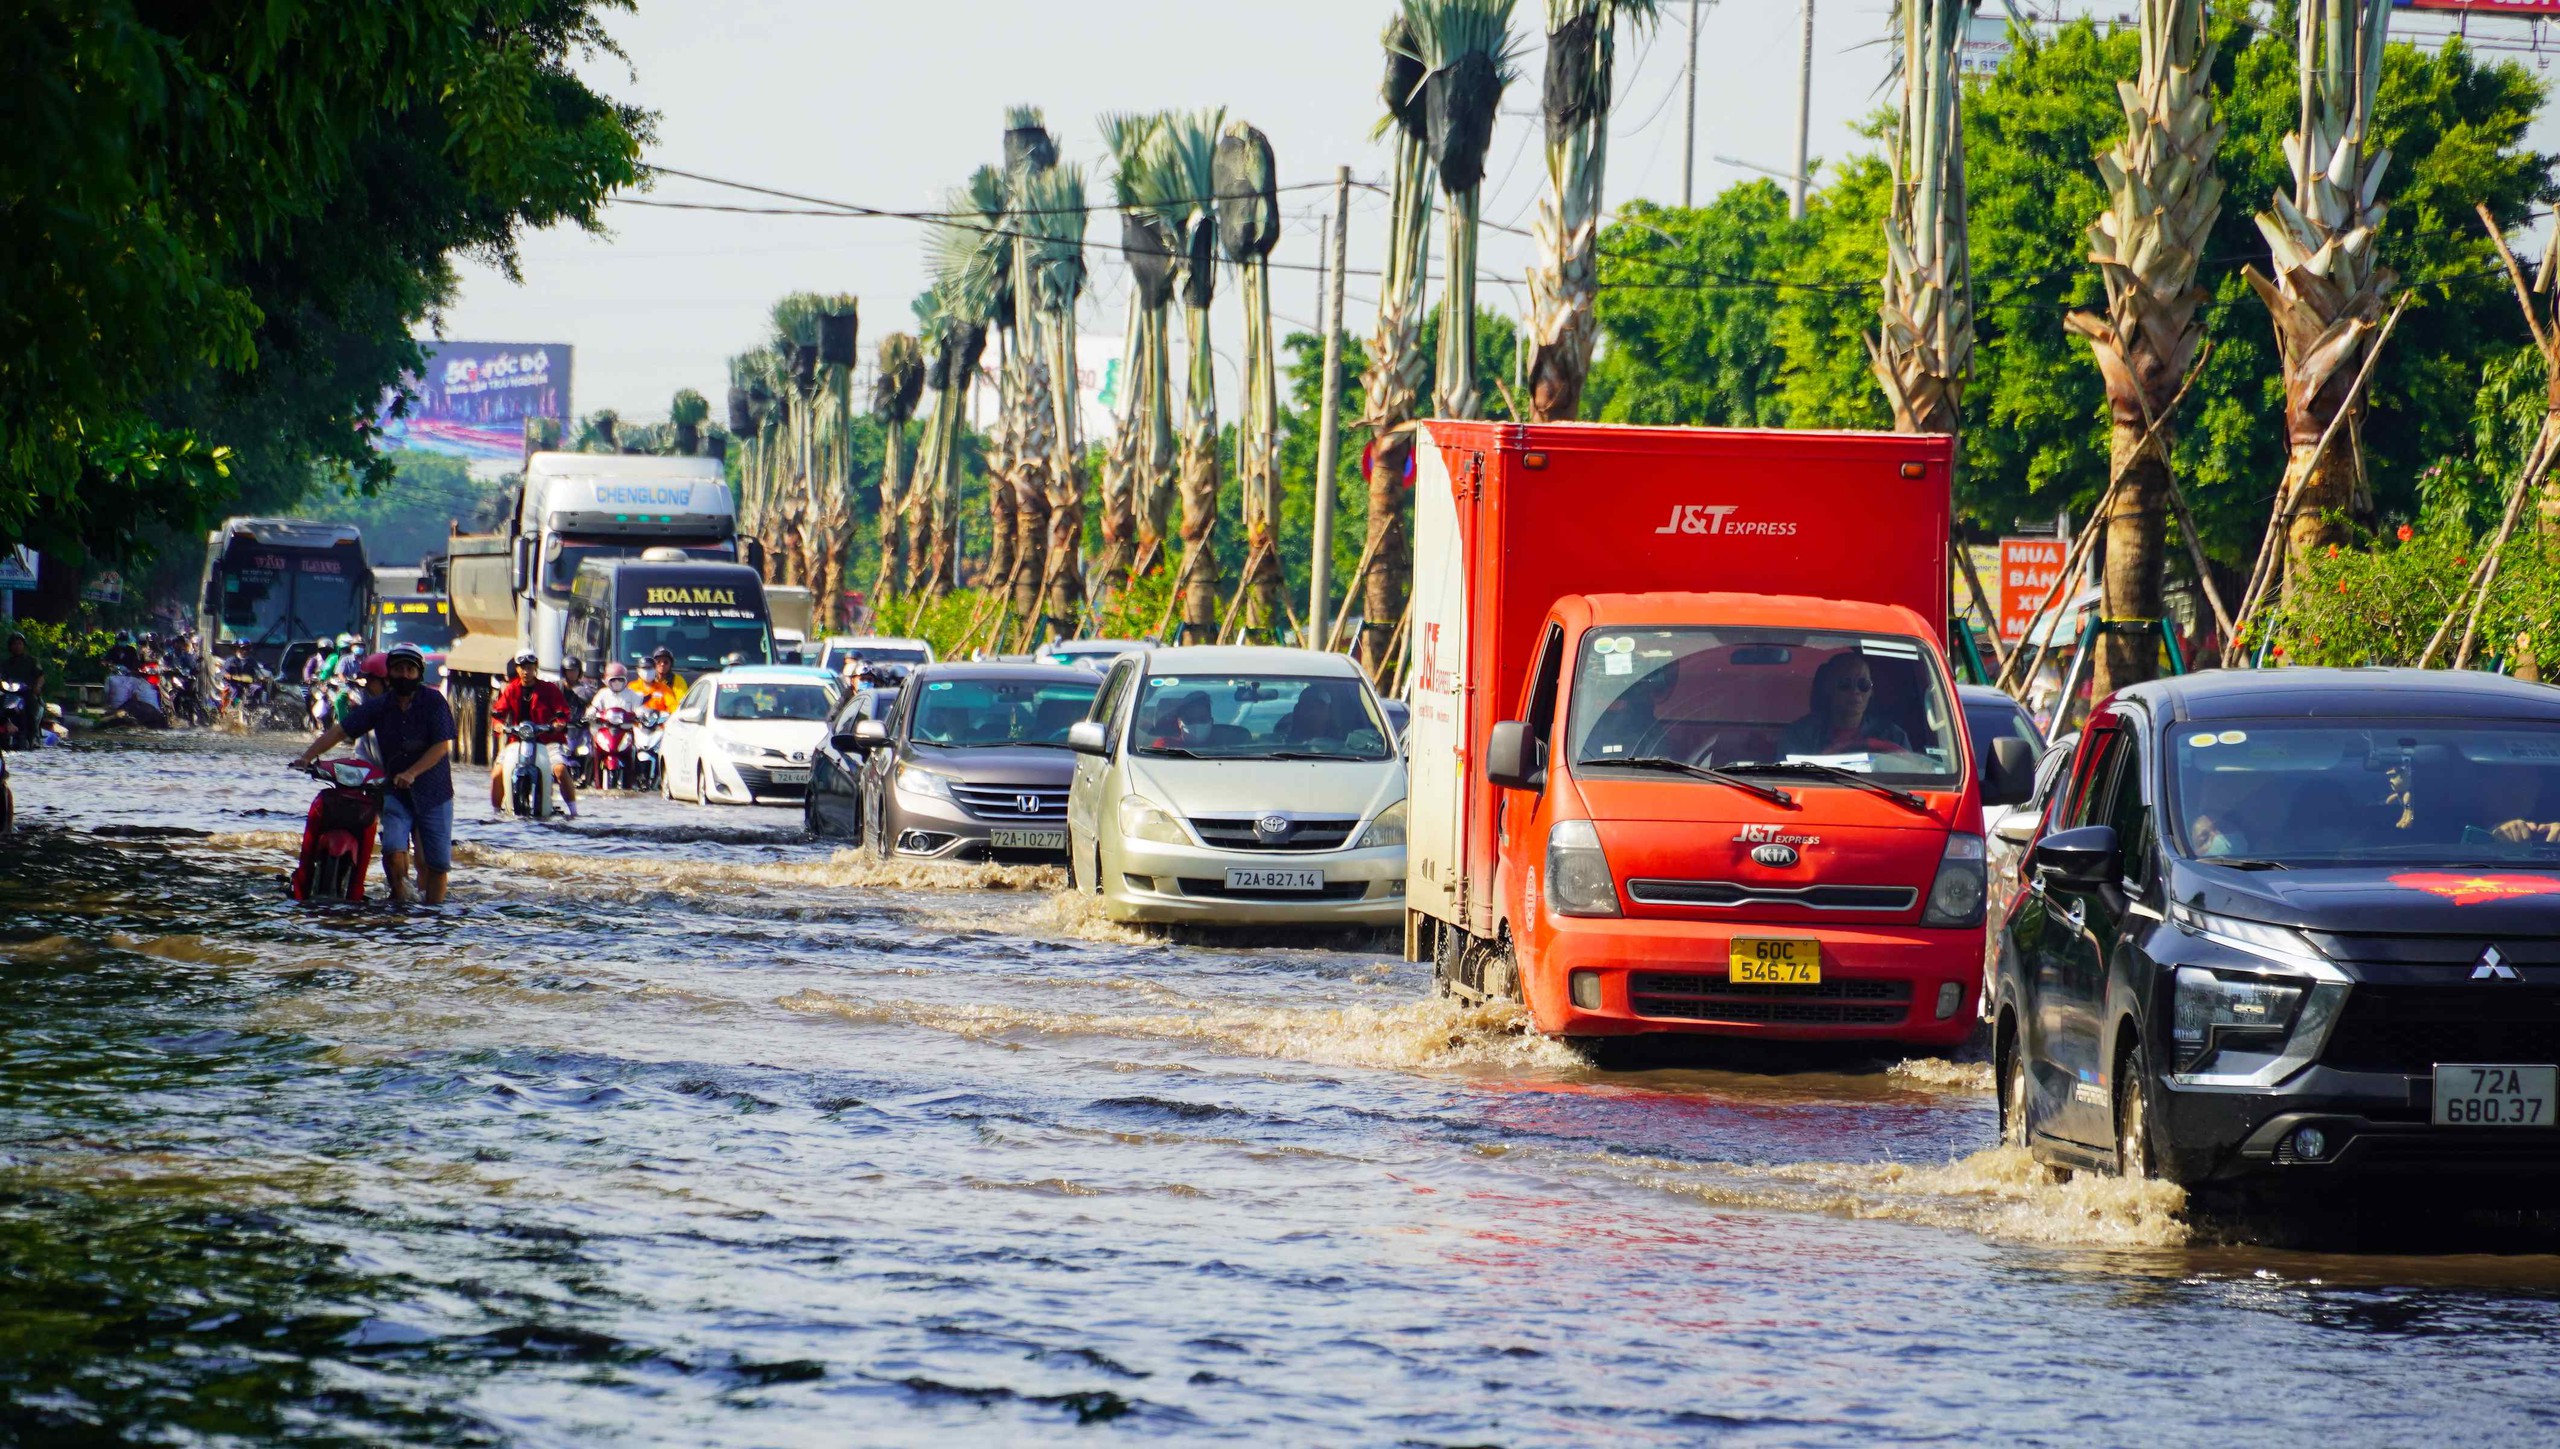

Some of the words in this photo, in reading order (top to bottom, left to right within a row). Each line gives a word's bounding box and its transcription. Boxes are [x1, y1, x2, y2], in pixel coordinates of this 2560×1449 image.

[596, 486, 689, 506] CHENGLONG
[1655, 504, 1739, 534] J&T
[1725, 521, 1797, 535] EXPRESS
[2008, 546, 2058, 563] MUA
[2009, 566, 2058, 588] BÁN
[994, 832, 1062, 847] 72A-102.77
[1732, 823, 1785, 842] J&T
[1775, 835, 1820, 845] EXPRESS
[1760, 848, 1791, 862] KIA
[1234, 872, 1315, 887] 72A-827.14
[1757, 942, 1794, 960] 60C
[1742, 961, 1811, 981] 546.74
[2471, 1069, 2521, 1094] 72A
[2448, 1098, 2543, 1122] 680.37
